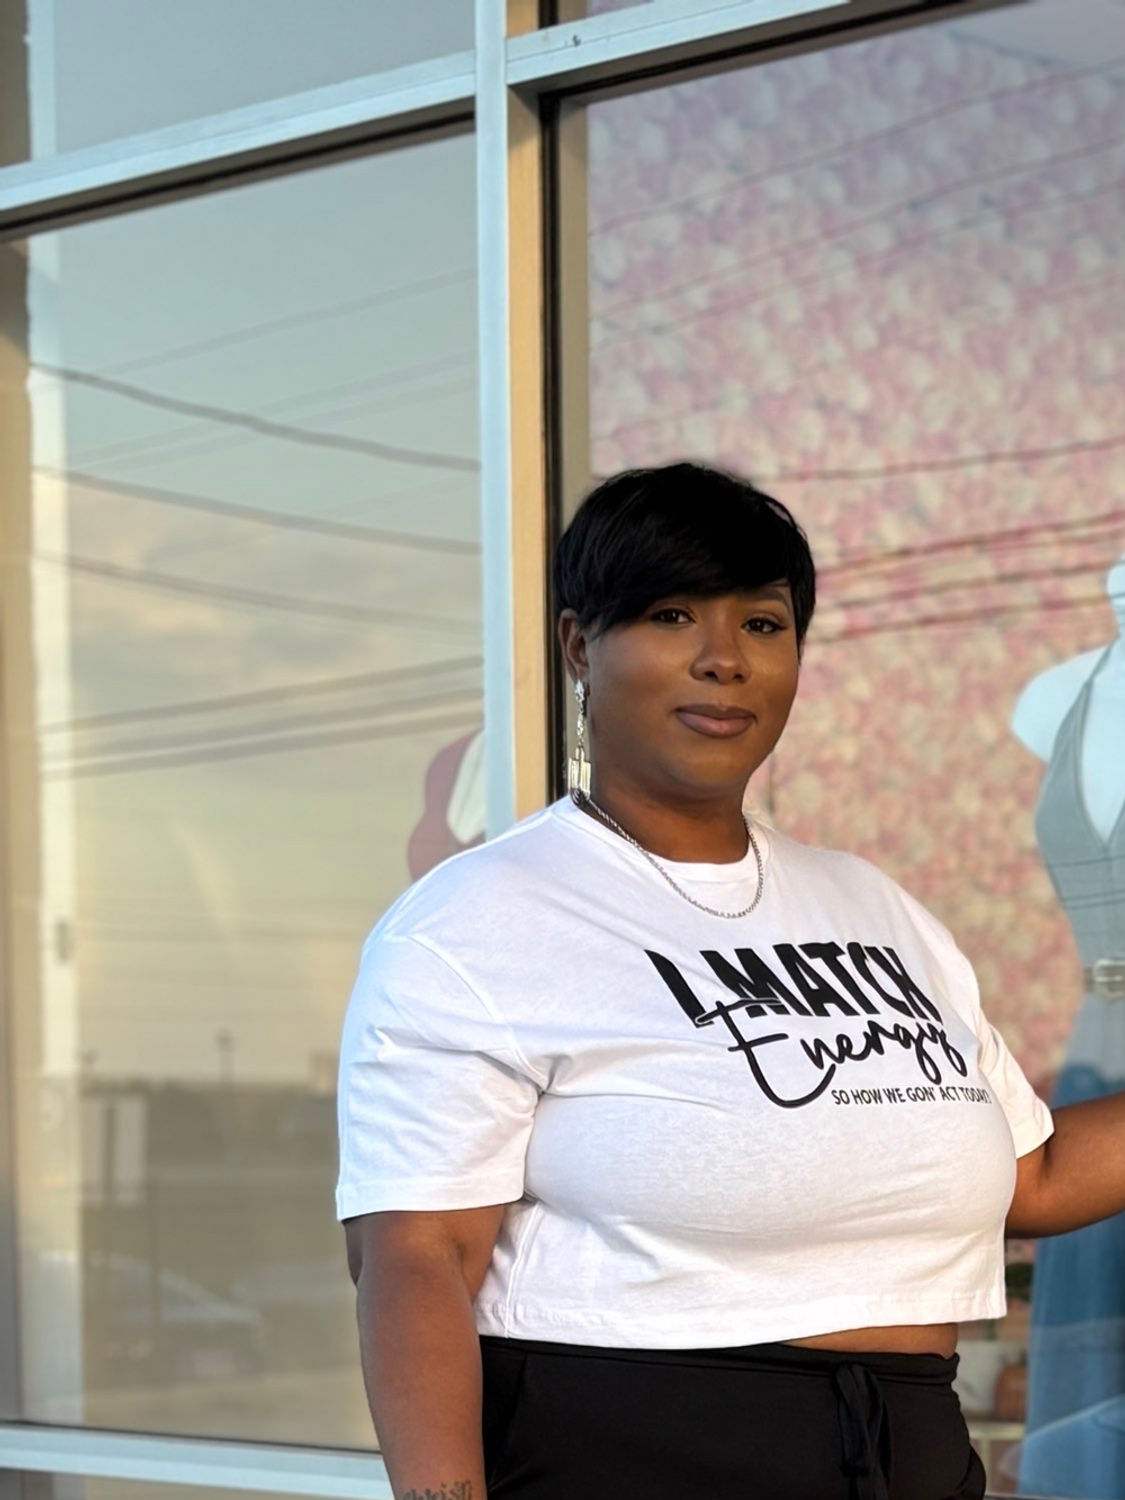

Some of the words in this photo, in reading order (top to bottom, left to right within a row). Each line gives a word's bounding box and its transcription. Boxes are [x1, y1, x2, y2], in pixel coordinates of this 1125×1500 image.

[643, 949, 714, 1028] I
[699, 941, 943, 1025] MATCH
[696, 998, 968, 1109] Energy
[831, 1089, 850, 1105] SO
[850, 1089, 883, 1105] HOW
[882, 1087, 906, 1104] WE
[906, 1086, 936, 1102] GON'
[939, 1086, 961, 1102] ACT
